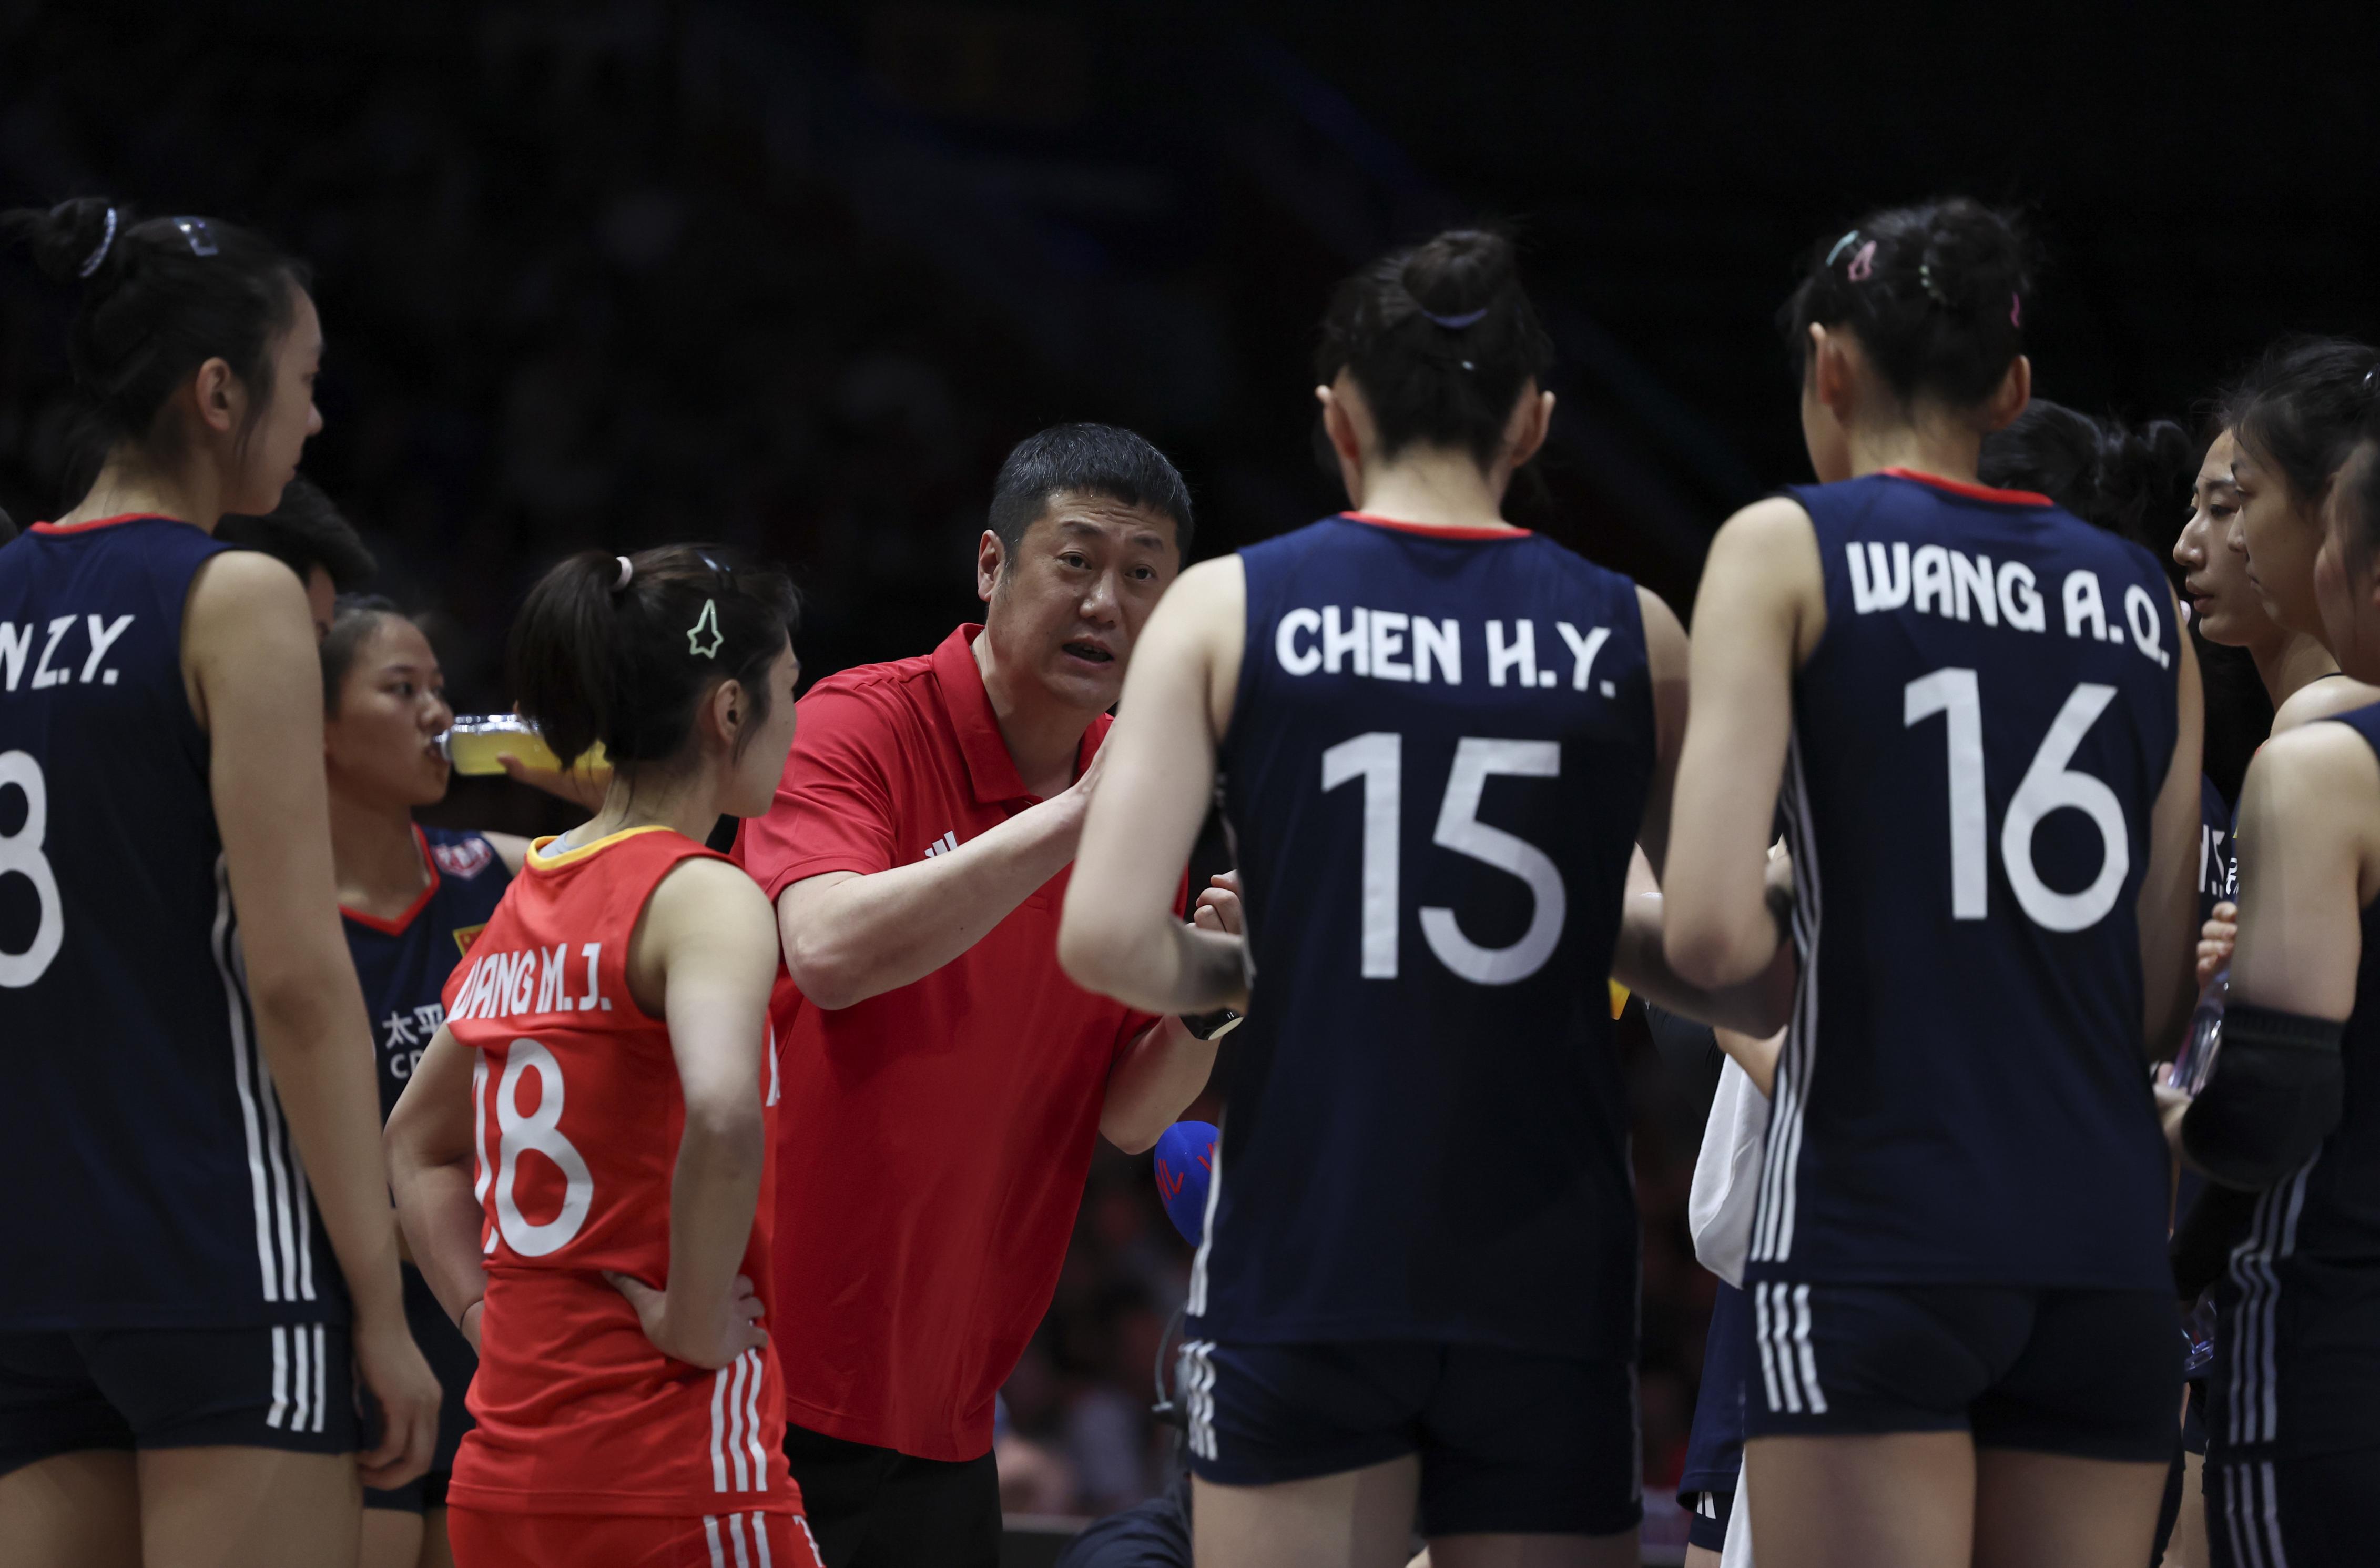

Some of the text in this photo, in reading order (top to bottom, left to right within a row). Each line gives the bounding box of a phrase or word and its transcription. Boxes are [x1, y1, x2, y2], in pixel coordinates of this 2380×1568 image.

[1275, 605, 1616, 699] CHEN H.Y.
[1845, 541, 2170, 669] WANG A.Q.
[1321, 732, 1567, 986] 15
[1904, 666, 2130, 933] 16
